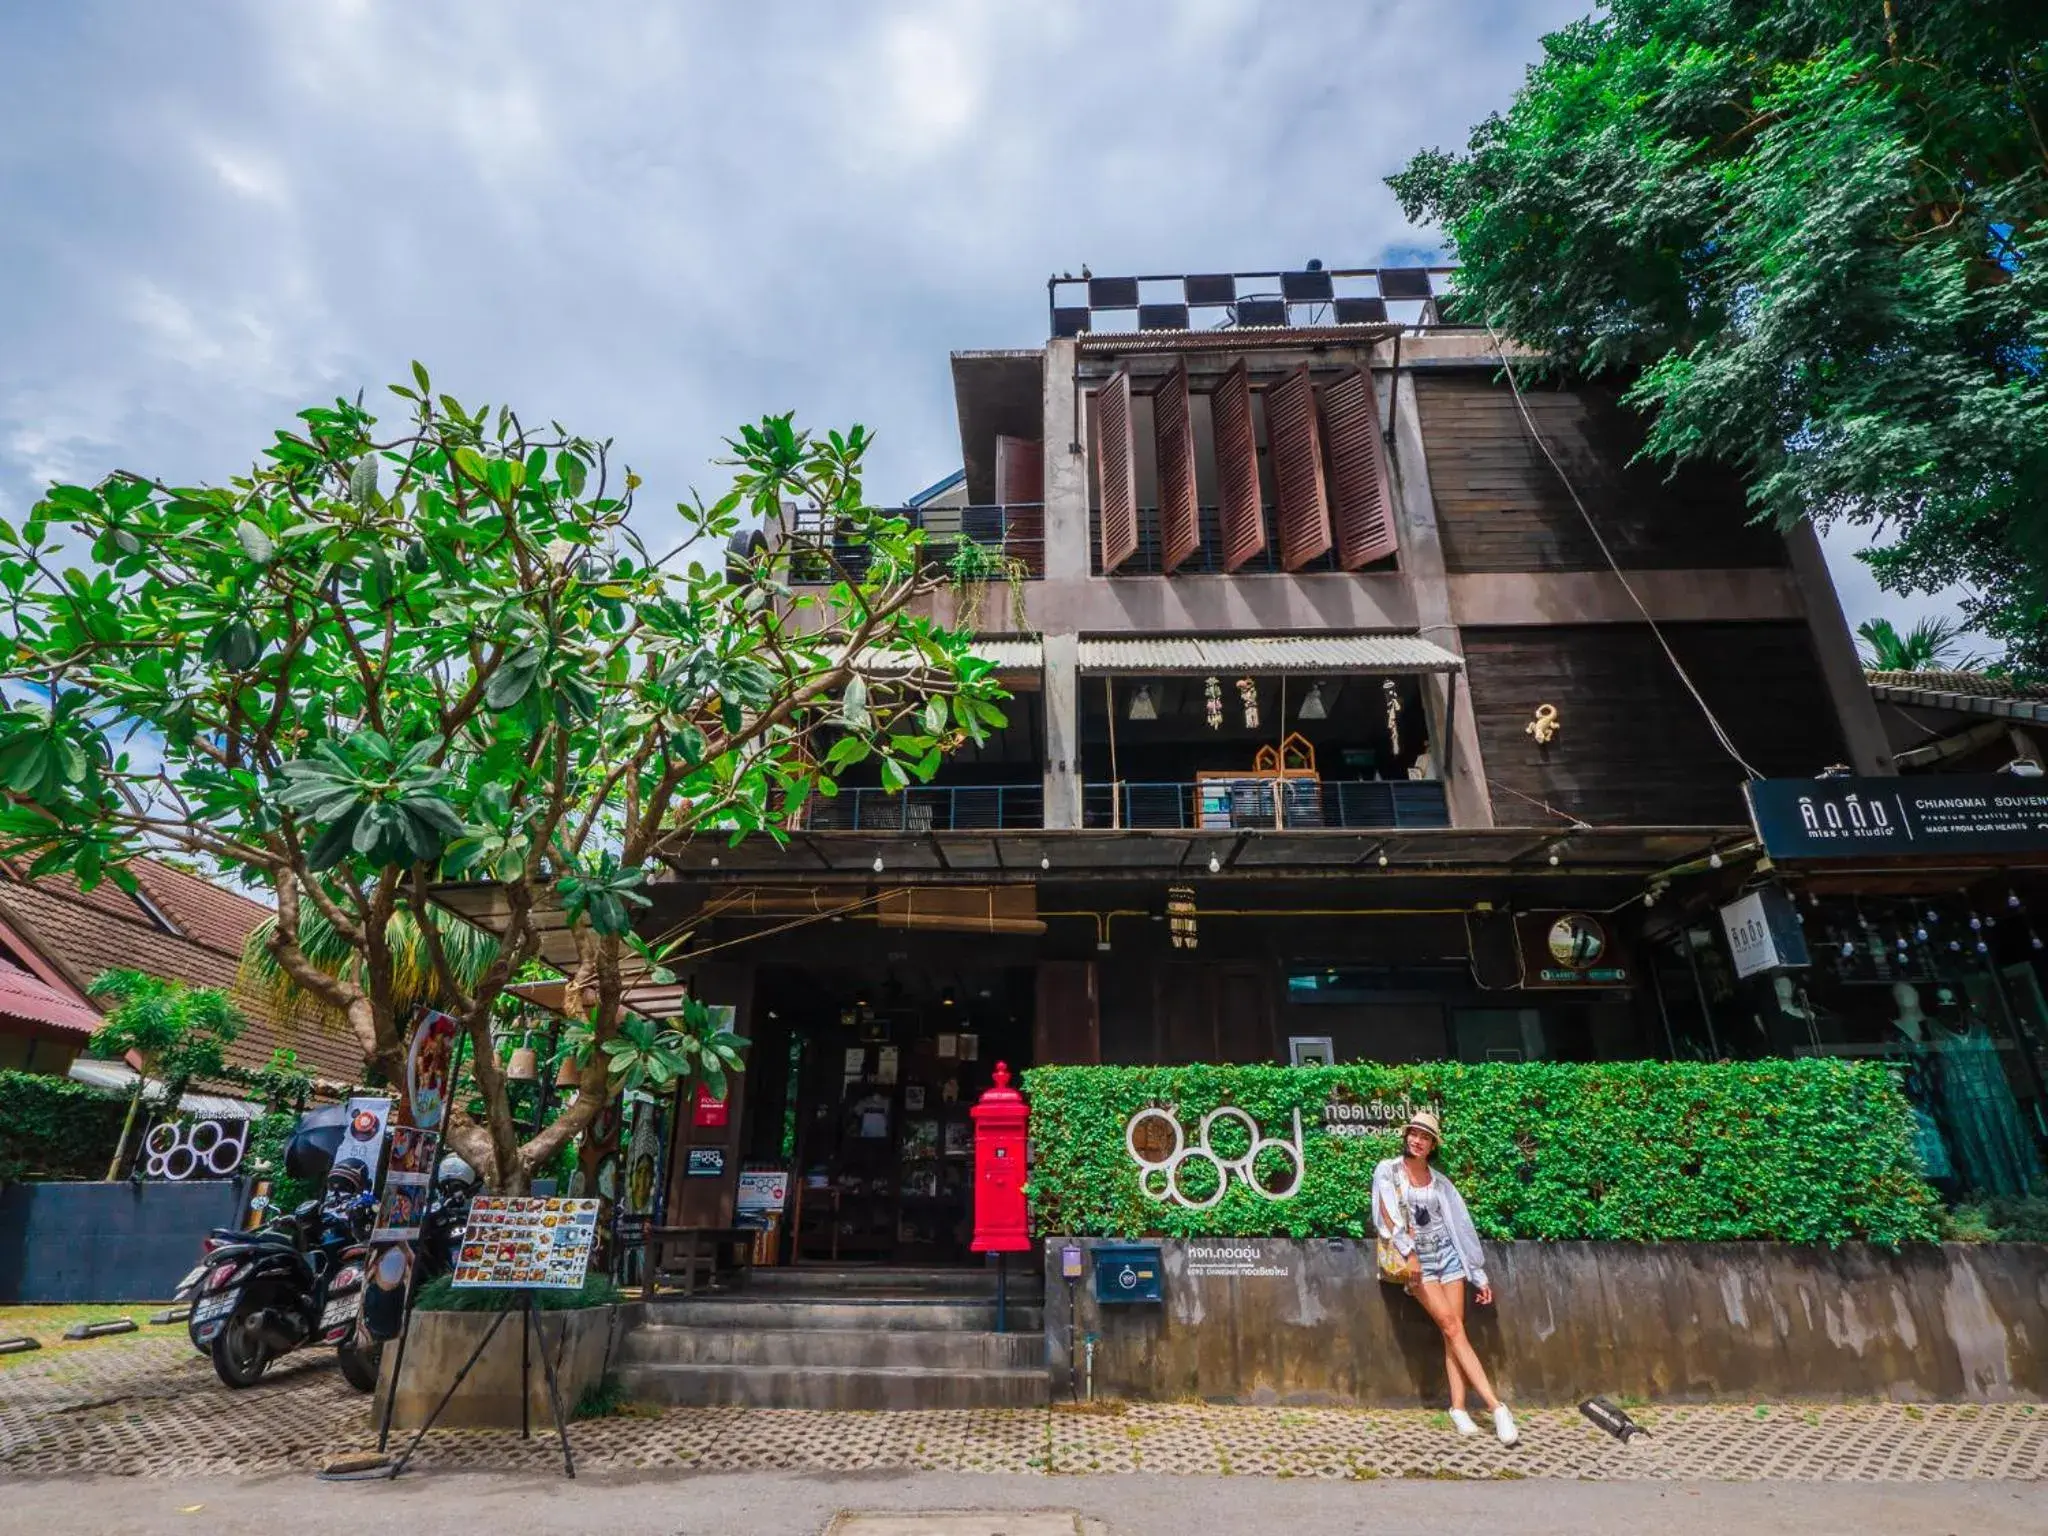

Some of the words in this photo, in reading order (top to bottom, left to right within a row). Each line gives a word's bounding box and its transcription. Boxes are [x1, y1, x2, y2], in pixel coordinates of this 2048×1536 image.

[1915, 798, 1986, 809] CHIANGMAI
[1808, 828, 1838, 838] miss
[1925, 825, 1950, 833] MADE
[1950, 824, 1975, 833] FROM
[1975, 823, 1994, 832] OUR
[1994, 822, 2028, 831] HEARTS
